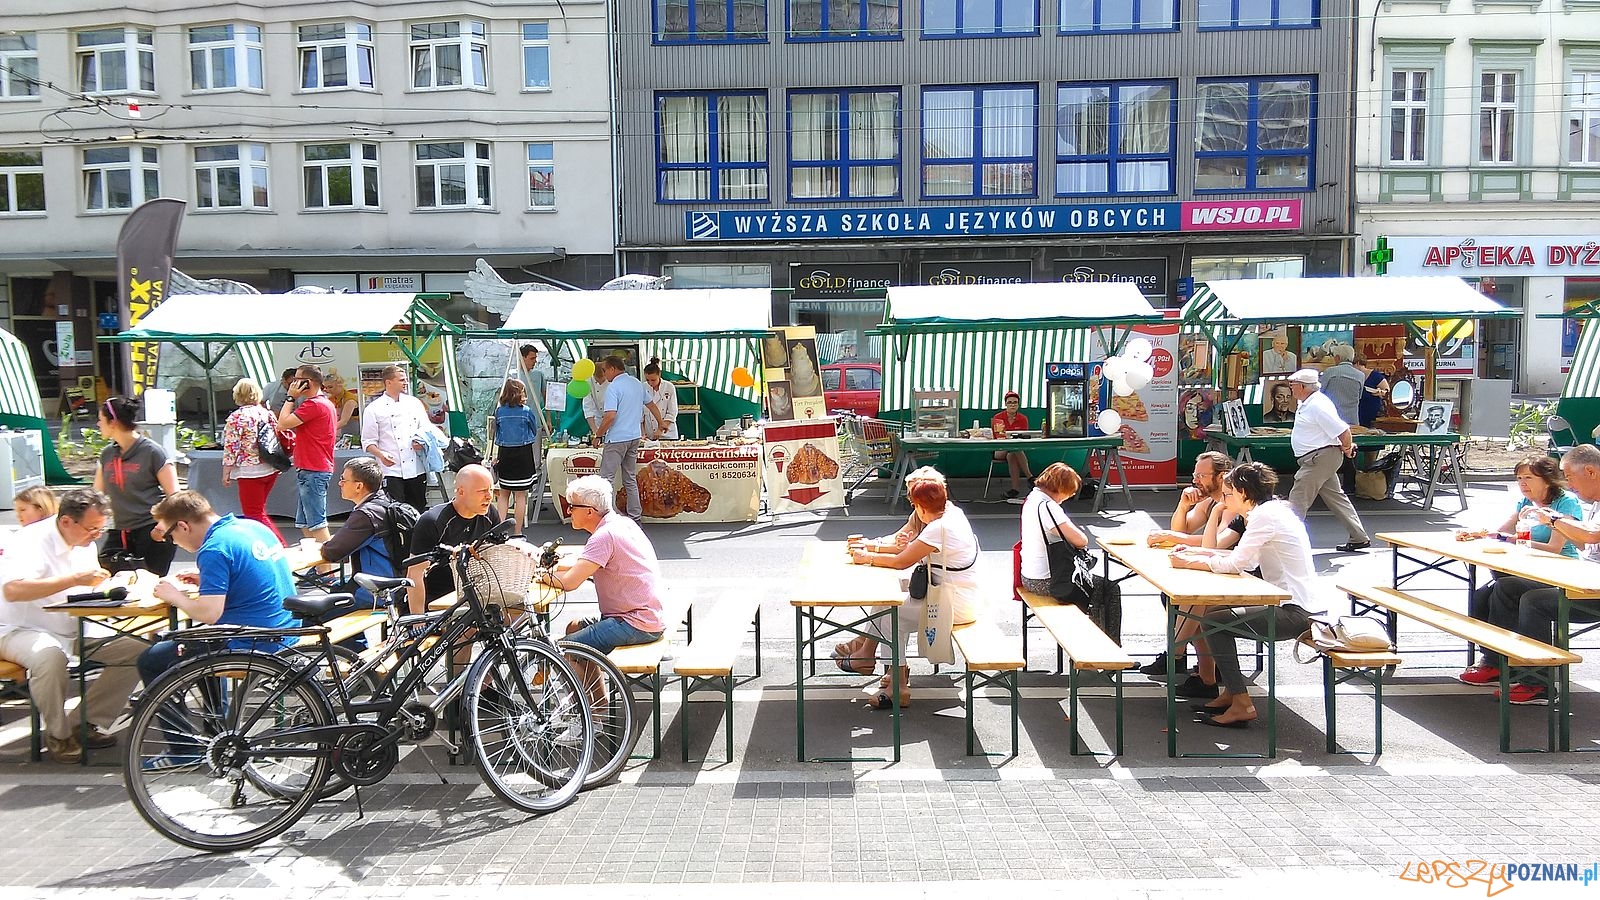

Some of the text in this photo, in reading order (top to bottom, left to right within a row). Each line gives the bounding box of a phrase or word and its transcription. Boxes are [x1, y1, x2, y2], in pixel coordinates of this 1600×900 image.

[734, 207, 1166, 234] WYŻSZA SZKOŁA JĘZYKÓW OBCYCH
[1191, 205, 1294, 225] WSJO.PL
[1424, 242, 1536, 267] APTEKA
[384, 276, 414, 284] matras
[129, 277, 152, 397] SPHNX
[1060, 367, 1084, 377] pepsi
[722, 471, 757, 479] 8520634
